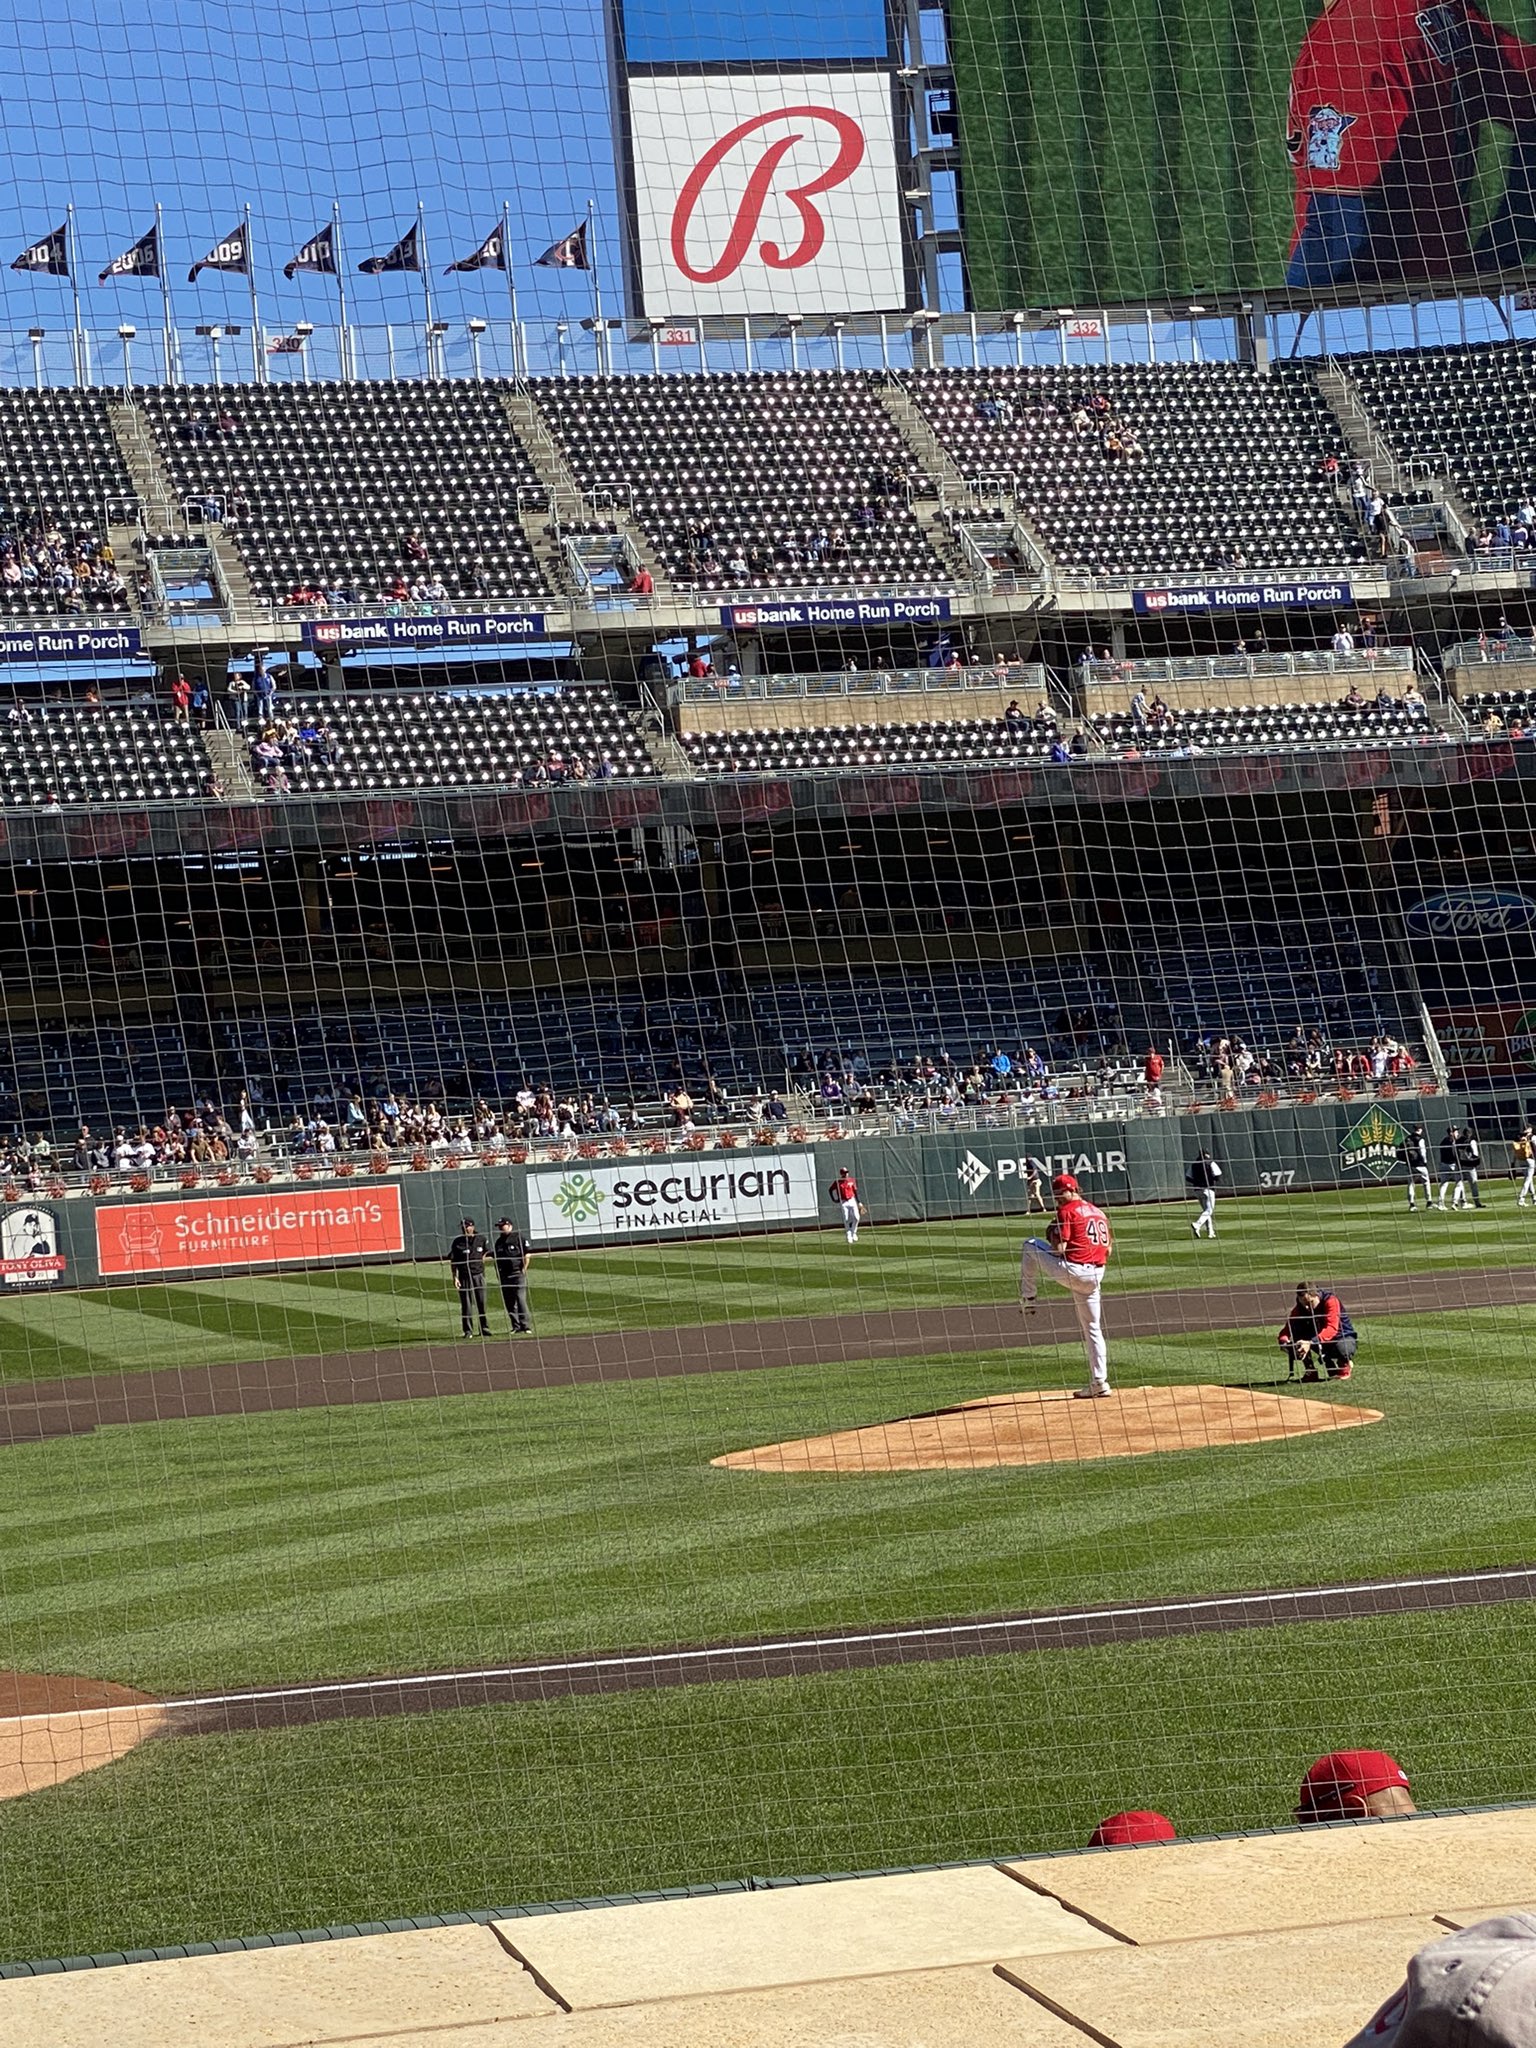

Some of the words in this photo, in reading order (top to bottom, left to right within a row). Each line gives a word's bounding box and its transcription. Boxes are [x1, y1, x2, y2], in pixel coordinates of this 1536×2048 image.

[671, 105, 865, 284] B
[207, 241, 243, 263] 009
[666, 329, 691, 342] 331
[1073, 321, 1098, 334] 332
[273, 337, 301, 350] 330
[1215, 589, 1260, 604] Home
[1263, 588, 1294, 603] Run
[1297, 585, 1341, 601] Porch
[808, 605, 855, 621] Home
[859, 604, 890, 619] Run
[894, 602, 940, 617] Porch
[394, 622, 443, 637] Home
[447, 620, 480, 635] Run
[485, 618, 533, 634] Porch
[0, 640, 34, 652] ome
[38, 636, 73, 651] Run
[78, 633, 129, 649] Porch
[1431, 897, 1512, 933] Ford
[1345, 1143, 1397, 1165] SUMM
[997, 1151, 1127, 1181] PENTAIR
[613, 1168, 790, 1208] securian
[1259, 1170, 1295, 1188] 377
[174, 1200, 381, 1237] Schneiderman's
[616, 1208, 721, 1228] FINANCIAL
[1086, 1218, 1109, 1247] 49
[179, 1235, 269, 1252] FURNITURE
[30, 1258, 62, 1269] OLIVA
